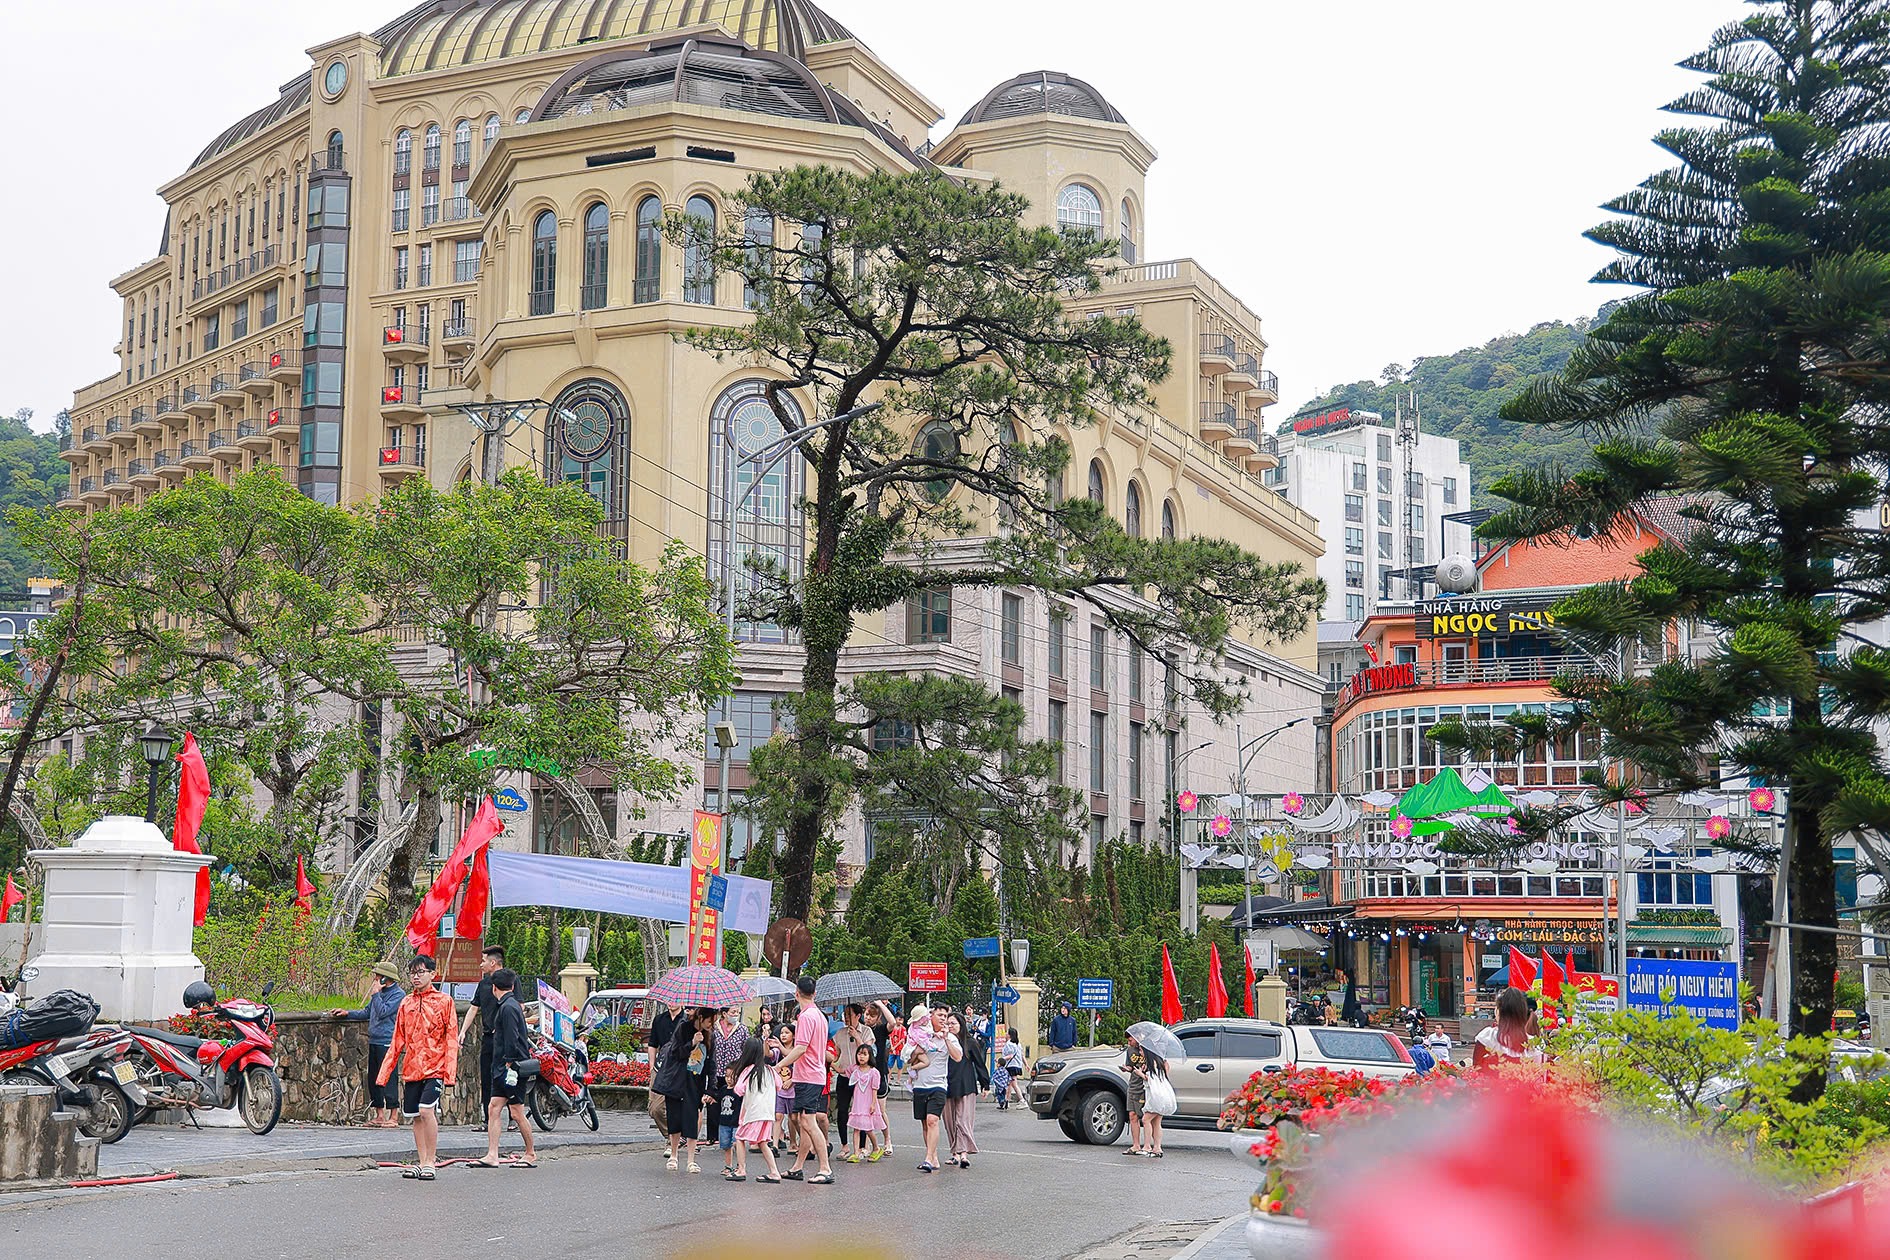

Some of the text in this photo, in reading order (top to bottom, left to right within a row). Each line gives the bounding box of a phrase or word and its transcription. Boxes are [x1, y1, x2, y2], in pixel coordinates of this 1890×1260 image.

[1423, 598, 1502, 614] NHÀ HÀNG
[1433, 613, 1498, 637] NGỌC
[1333, 842, 1383, 858] TAM
[1390, 836, 1441, 858] ĐẢO
[1505, 919, 1522, 929] NHÀ
[1525, 919, 1547, 929] HÀNG
[1550, 920, 1573, 932] NGỌC
[1497, 931, 1523, 941] CƠM
[1563, 931, 1586, 943] ĐẶC
[458, 942, 473, 953] VỰC
[1630, 965, 1733, 998] CẢNH BÁO NGUY HIỂM
